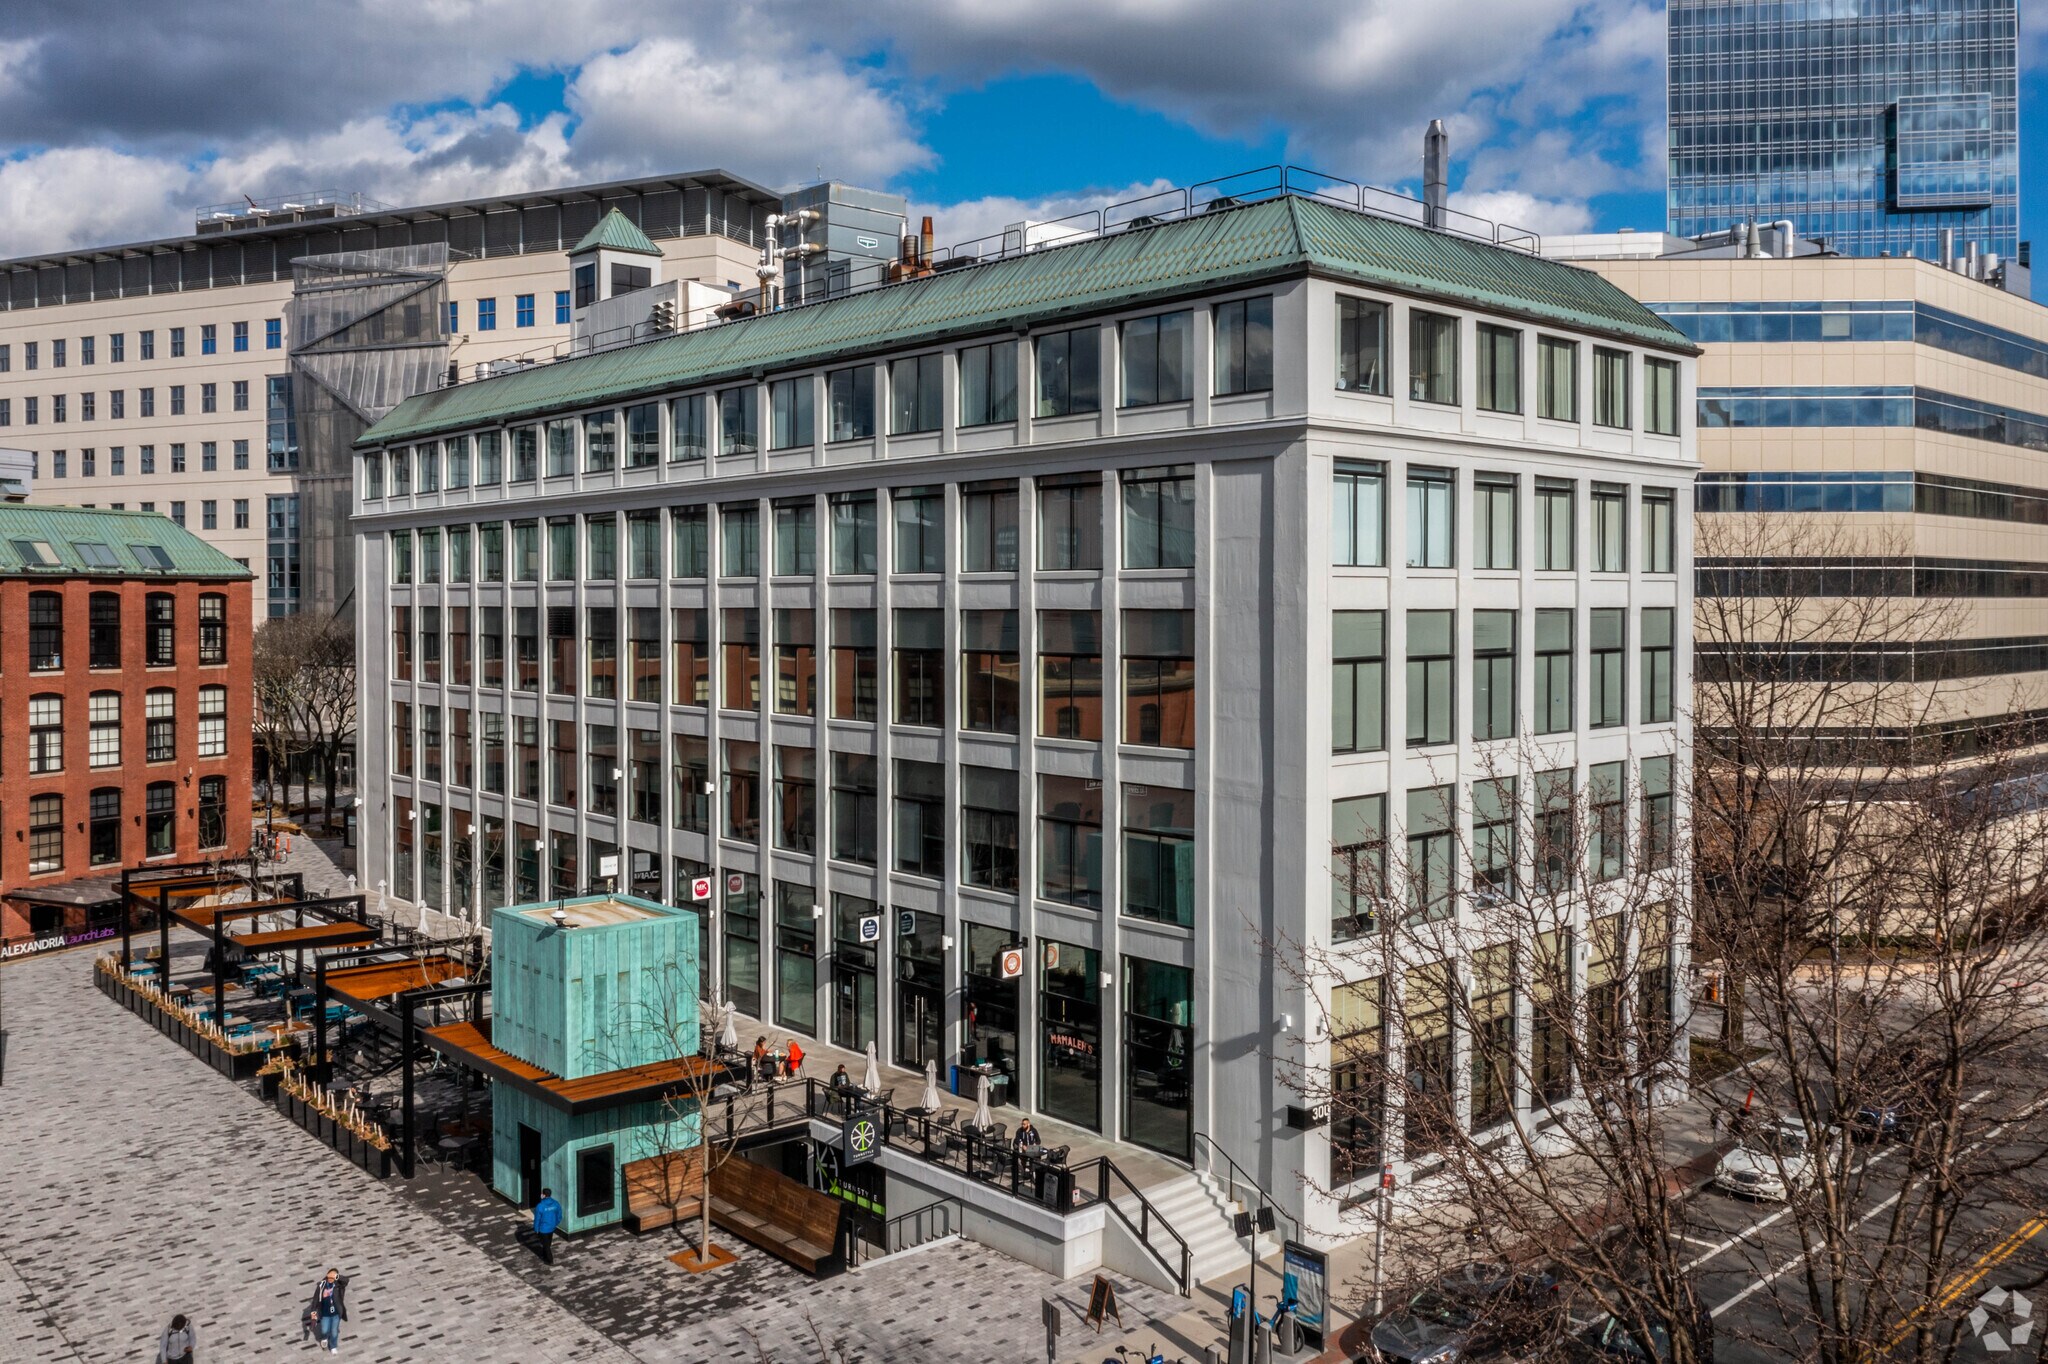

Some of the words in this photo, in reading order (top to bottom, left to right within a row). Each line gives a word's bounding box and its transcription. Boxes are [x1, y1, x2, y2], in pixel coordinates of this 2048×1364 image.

[0, 935, 65, 958] ALEXANDRIA
[65, 927, 116, 945] LaunchLabs
[1050, 1033, 1093, 1055] MAMALEH'S
[1312, 1104, 1331, 1120] 300
[838, 1178, 878, 1202] TURNSTYE
